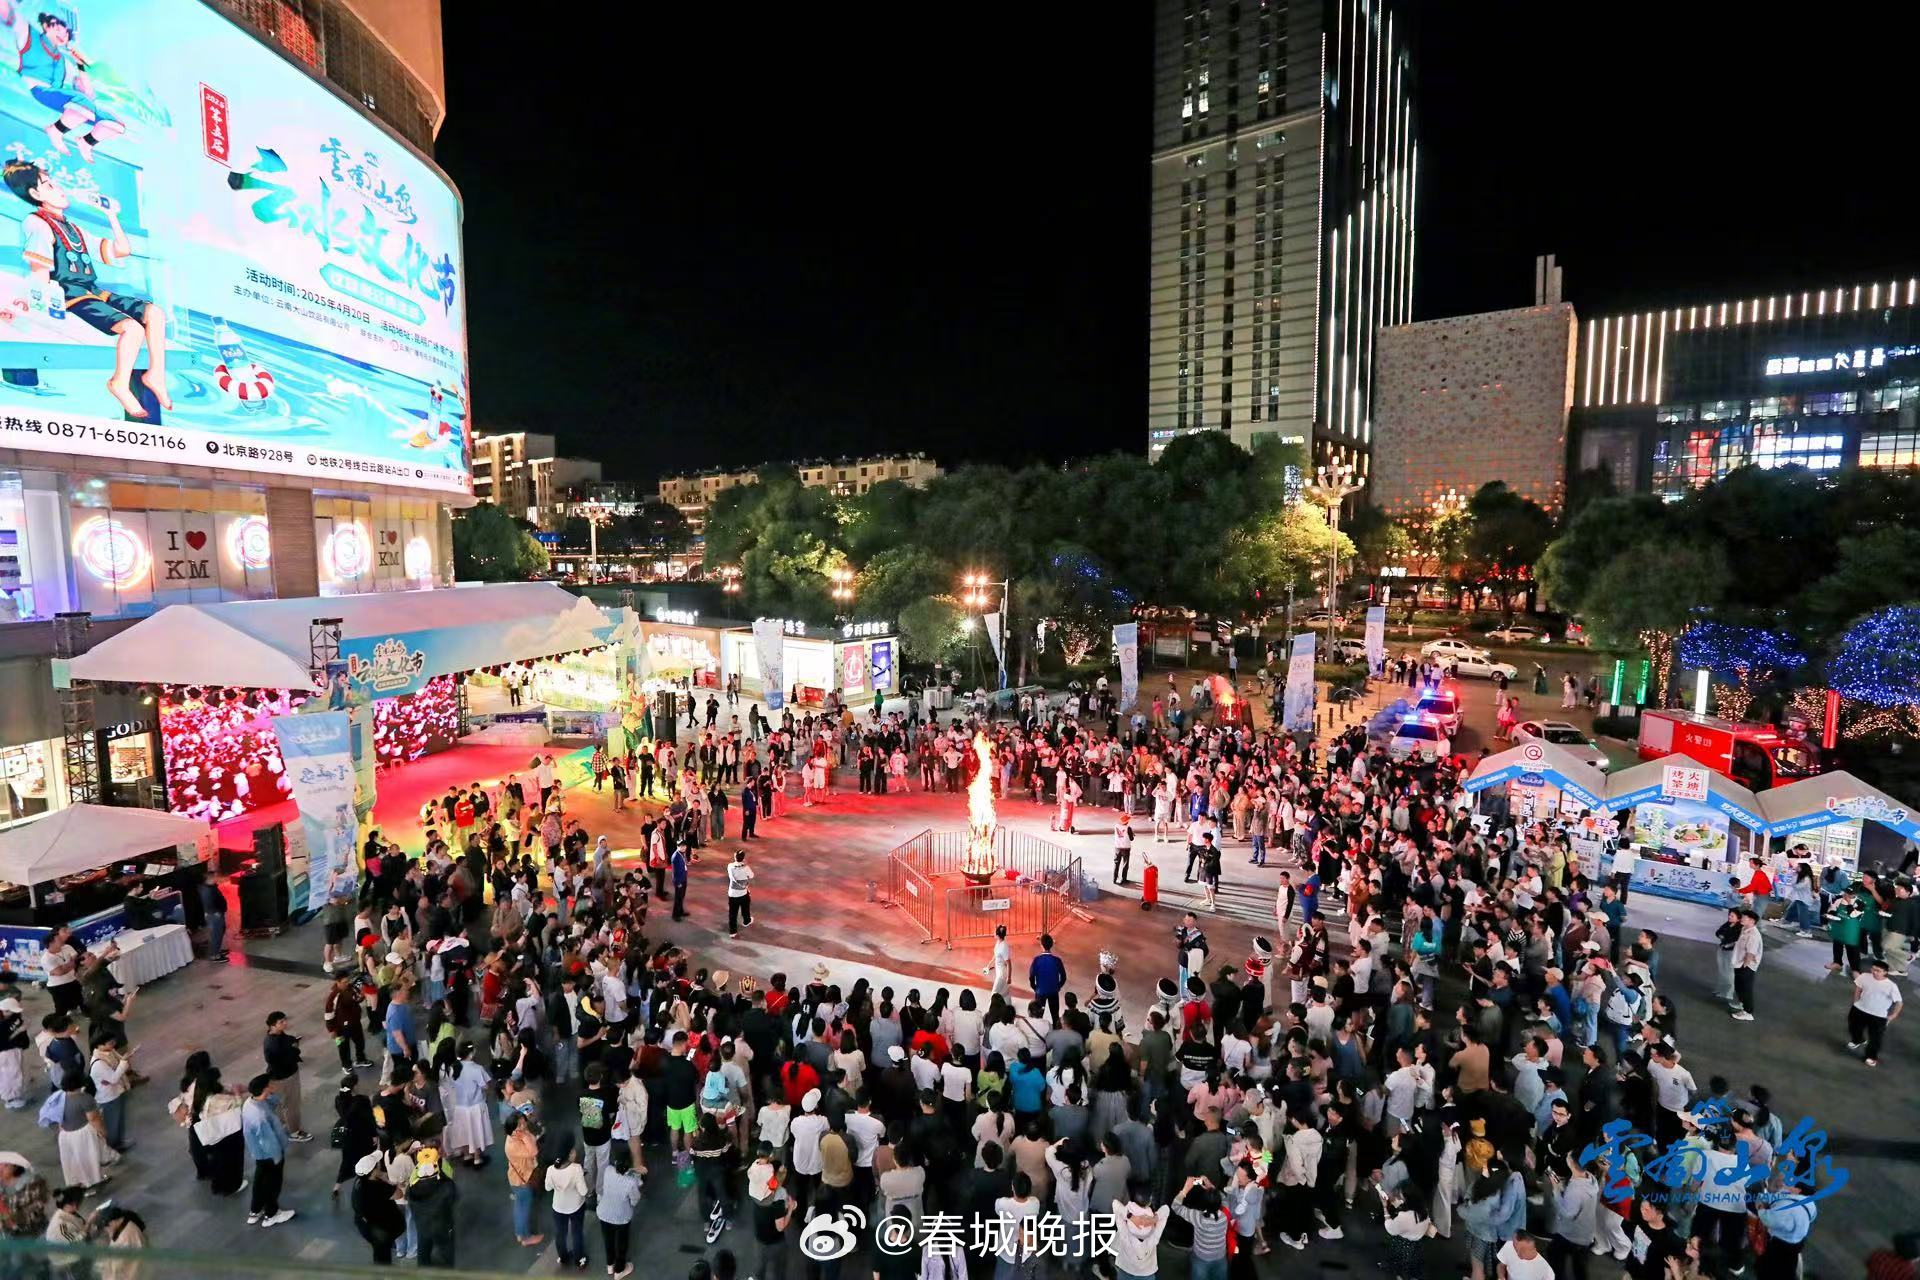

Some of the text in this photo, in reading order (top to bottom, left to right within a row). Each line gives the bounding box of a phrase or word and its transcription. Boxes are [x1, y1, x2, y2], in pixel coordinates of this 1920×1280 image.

[227, 146, 456, 318] 云水文化节
[0, 416, 187, 450] 热线 0871-65021166
[222, 443, 294, 463] 北京路928号
[319, 456, 410, 477] 地铁2号线白云路站A出口
[167, 531, 179, 550] I
[380, 531, 386, 545] I
[378, 551, 400, 566] KM
[164, 560, 210, 579] KM
